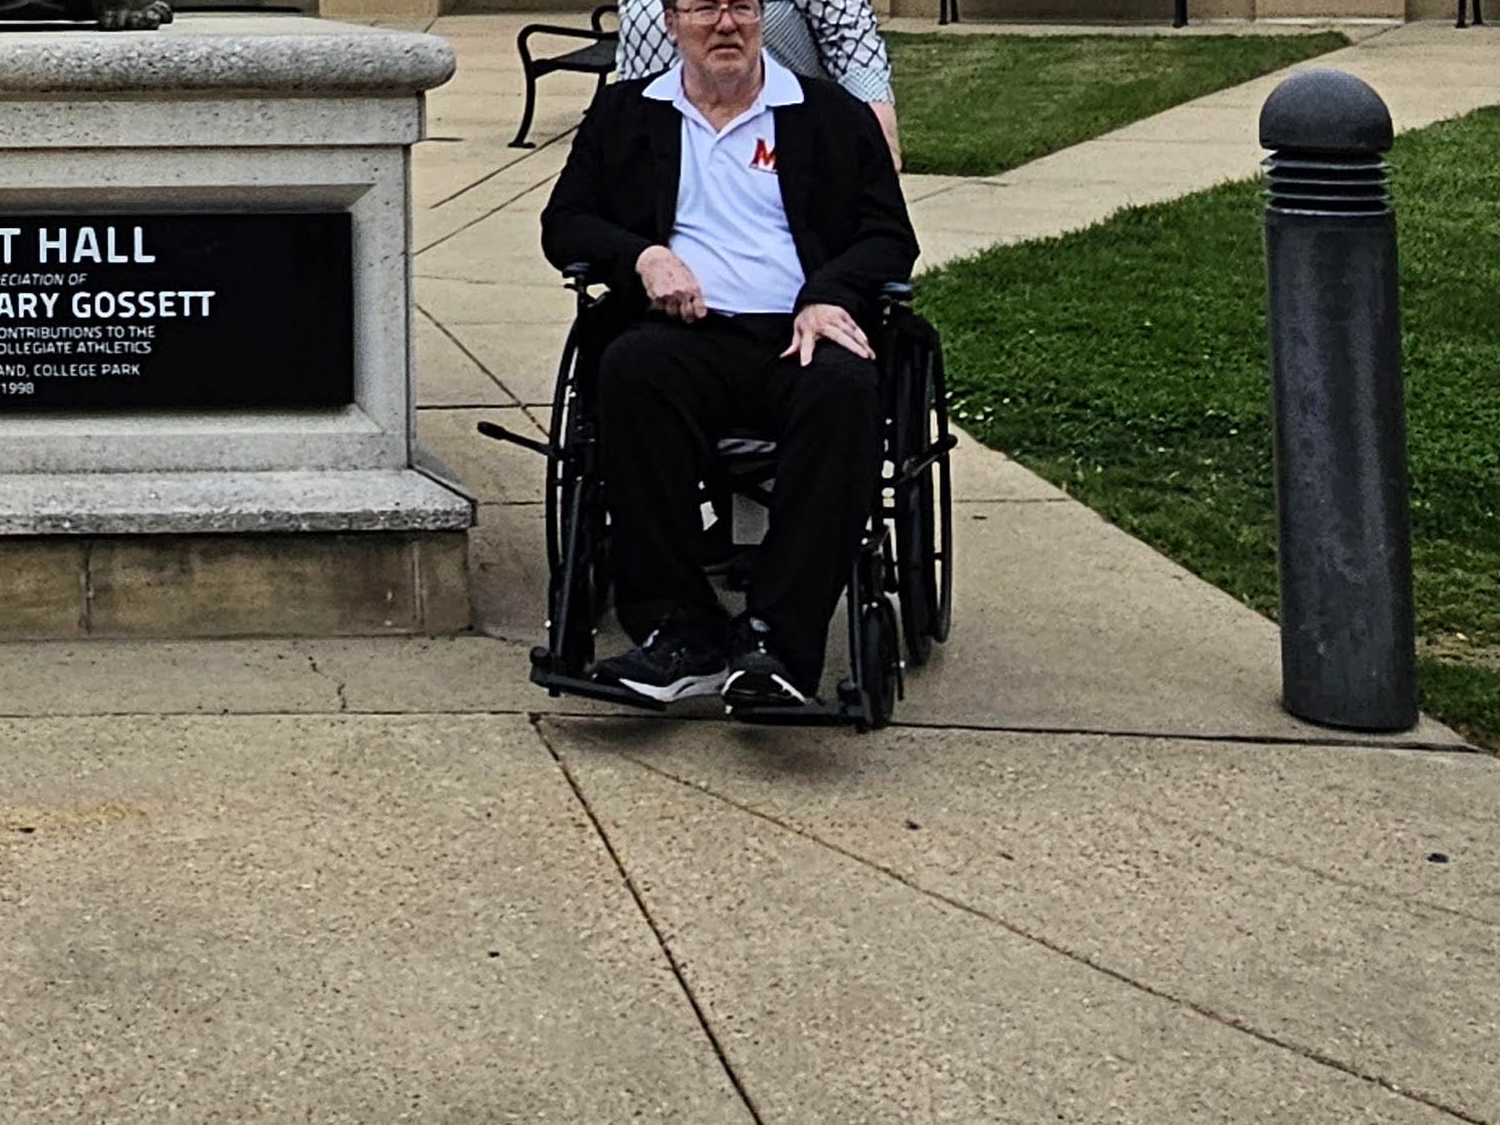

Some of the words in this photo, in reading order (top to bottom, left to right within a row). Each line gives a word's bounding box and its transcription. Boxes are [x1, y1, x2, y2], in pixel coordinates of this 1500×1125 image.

[750, 137, 781, 171] M
[39, 226, 155, 263] HALL
[69, 274, 87, 285] OF
[72, 291, 215, 318] GOSSETT
[106, 326, 124, 338] TO
[128, 326, 155, 337] THE
[77, 342, 151, 353] ATHLETICS
[34, 364, 95, 376] COLLEGE
[102, 364, 139, 374] PARK
[2, 382, 34, 394] 1998
